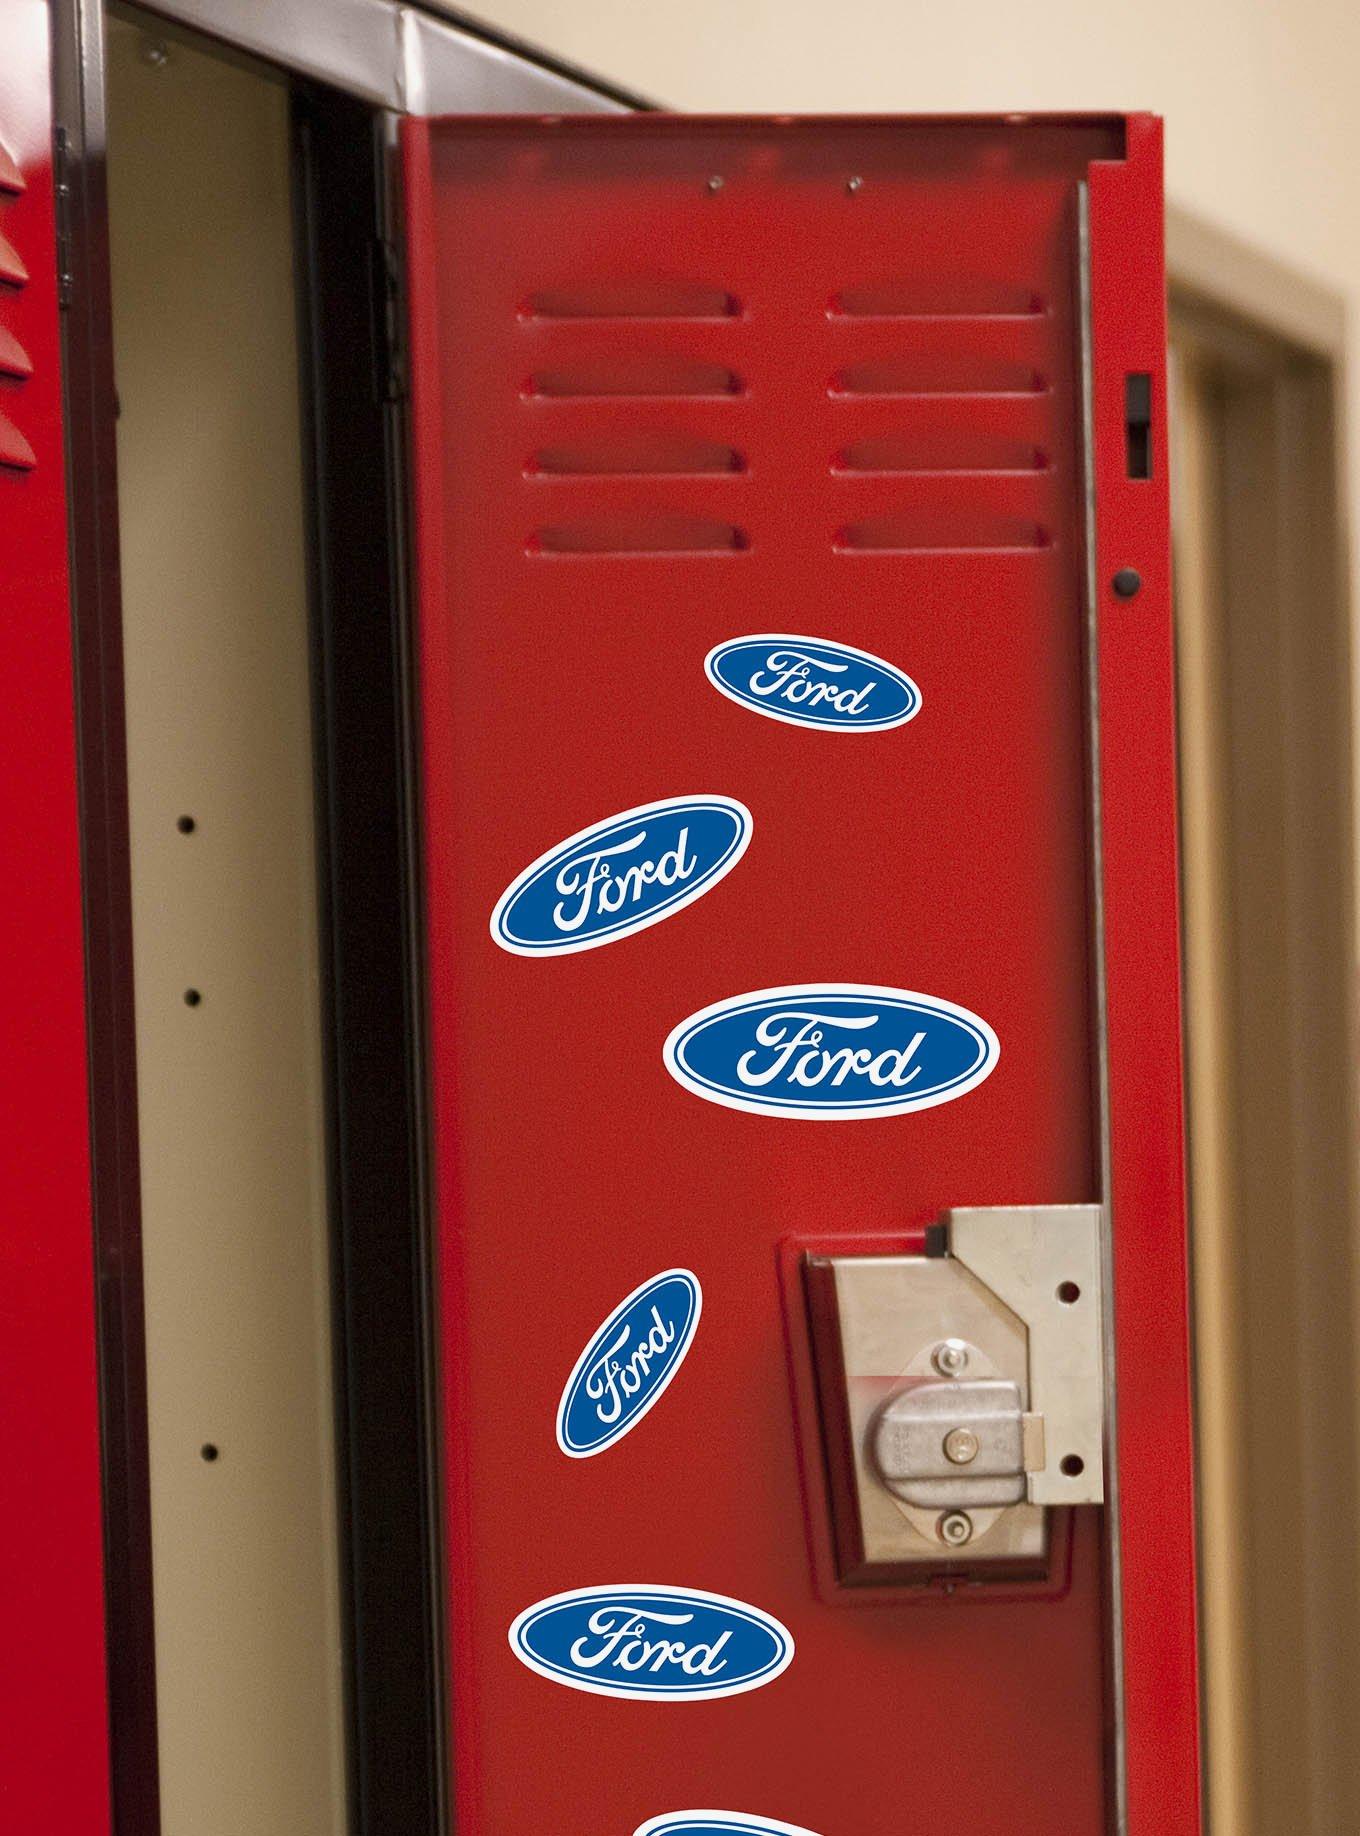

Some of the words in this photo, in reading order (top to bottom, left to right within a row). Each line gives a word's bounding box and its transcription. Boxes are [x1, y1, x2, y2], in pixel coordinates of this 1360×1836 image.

[749, 650, 877, 715] Ford
[553, 826, 698, 932] Ford
[736, 1011, 927, 1087] Ford
[585, 1305, 675, 1424] Ford
[570, 1606, 734, 1676] Ford
